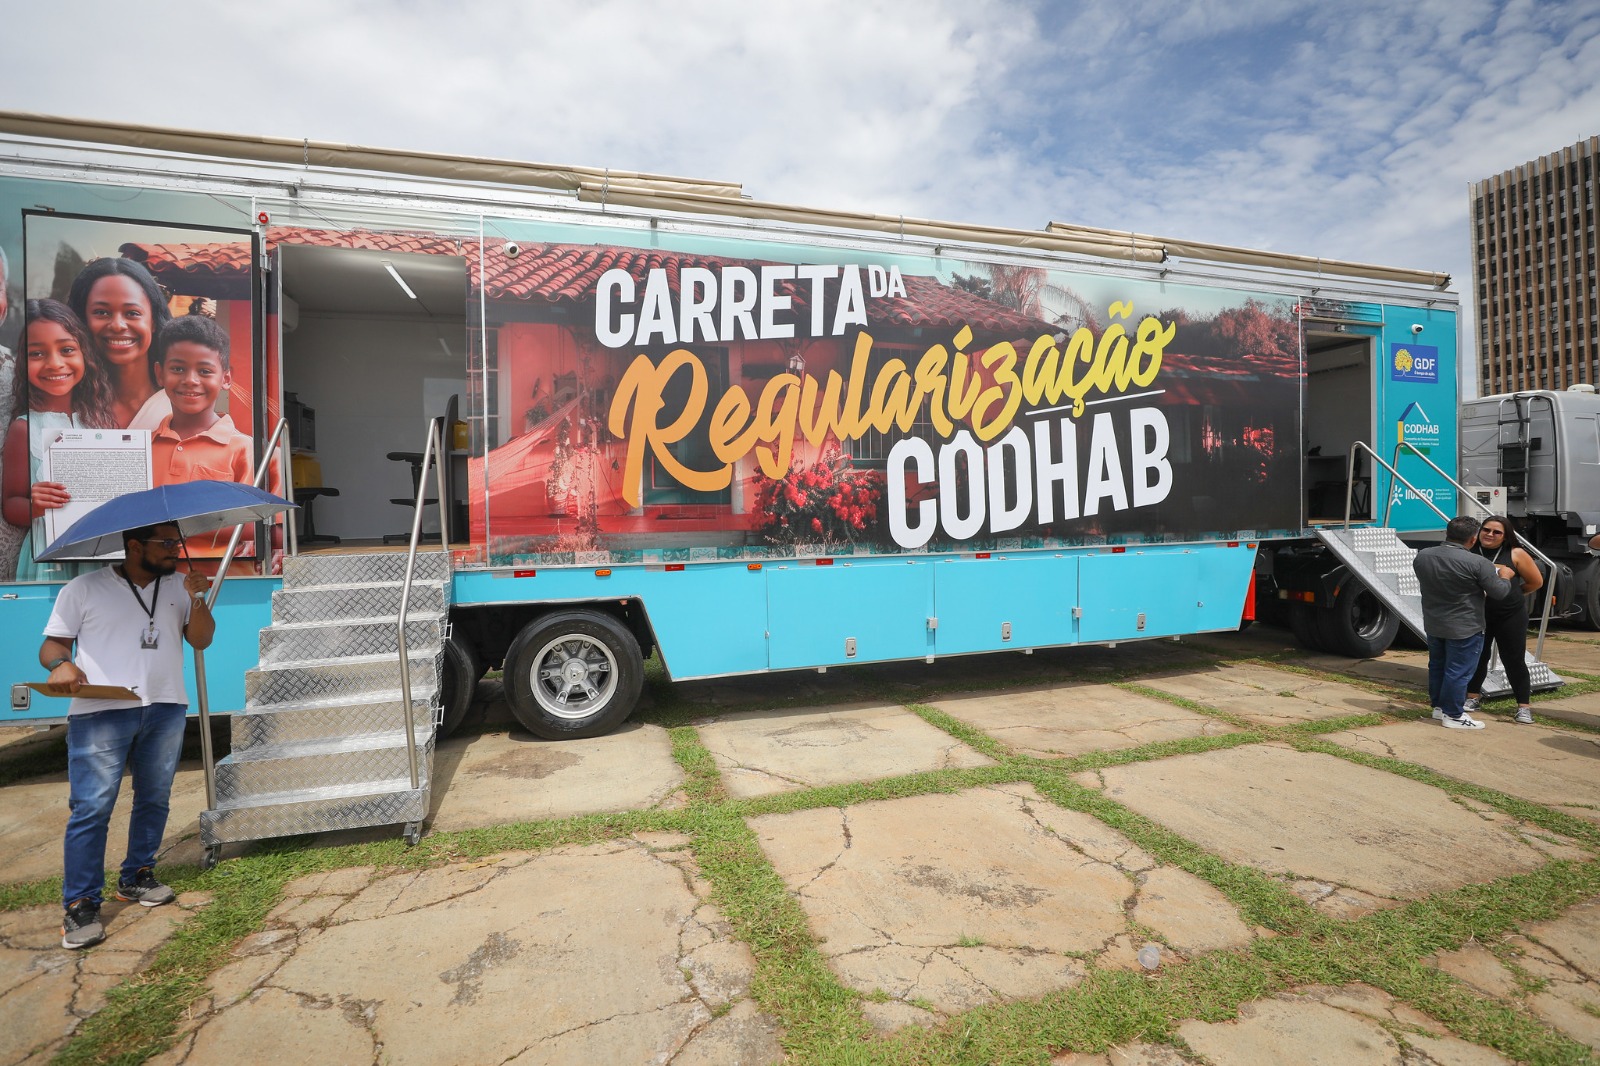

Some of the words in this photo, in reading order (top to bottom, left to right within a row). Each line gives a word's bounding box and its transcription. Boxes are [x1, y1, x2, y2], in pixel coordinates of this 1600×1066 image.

[594, 263, 868, 349] CARRETA
[868, 263, 908, 299] DA
[608, 300, 1177, 509] Regularização
[1414, 357, 1436, 371] GDF
[1404, 423, 1440, 435] CODHAB
[886, 406, 1174, 550] CODHAB
